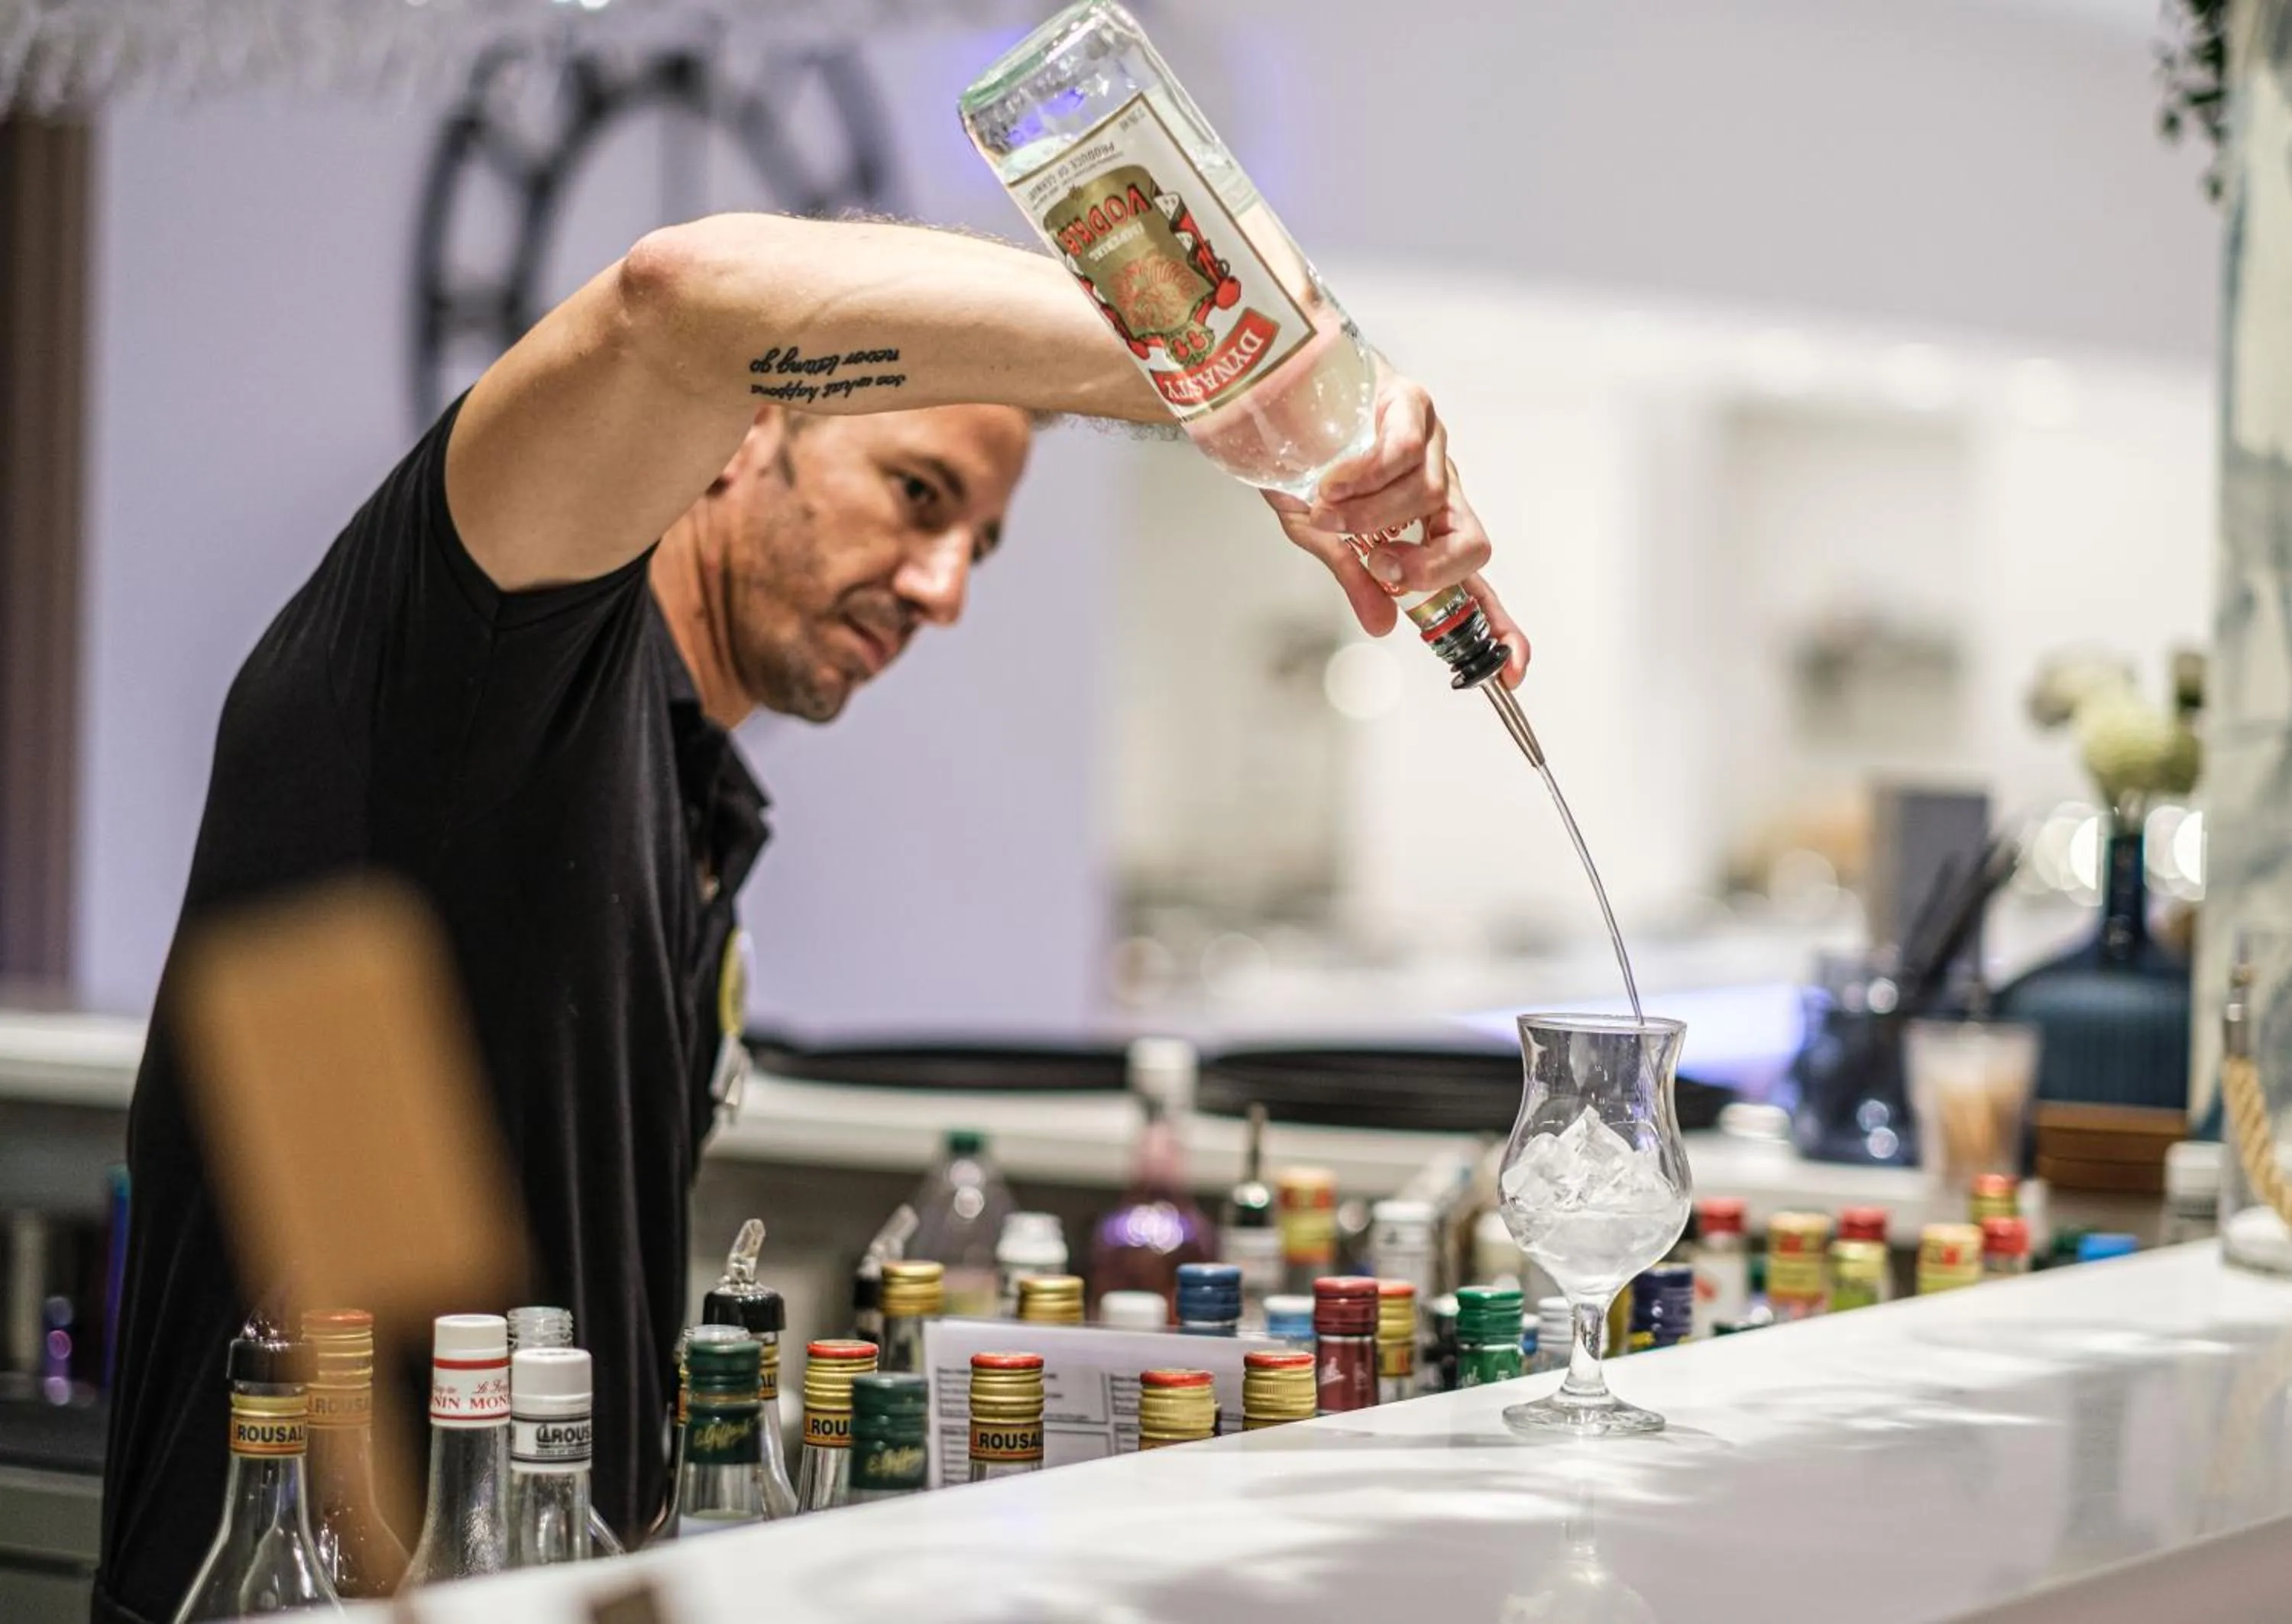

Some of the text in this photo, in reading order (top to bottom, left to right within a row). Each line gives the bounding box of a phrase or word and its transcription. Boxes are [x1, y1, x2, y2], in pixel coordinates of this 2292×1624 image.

[1057, 183, 1152, 257] VODKA
[749, 347, 781, 374] go
[842, 348, 899, 365] never
[1164, 328, 1264, 400] DYNASTY
[821, 377, 873, 399] what
[432, 1395, 461, 1410] NIN
[470, 1393, 511, 1410] MON
[811, 1419, 853, 1435] ROU
